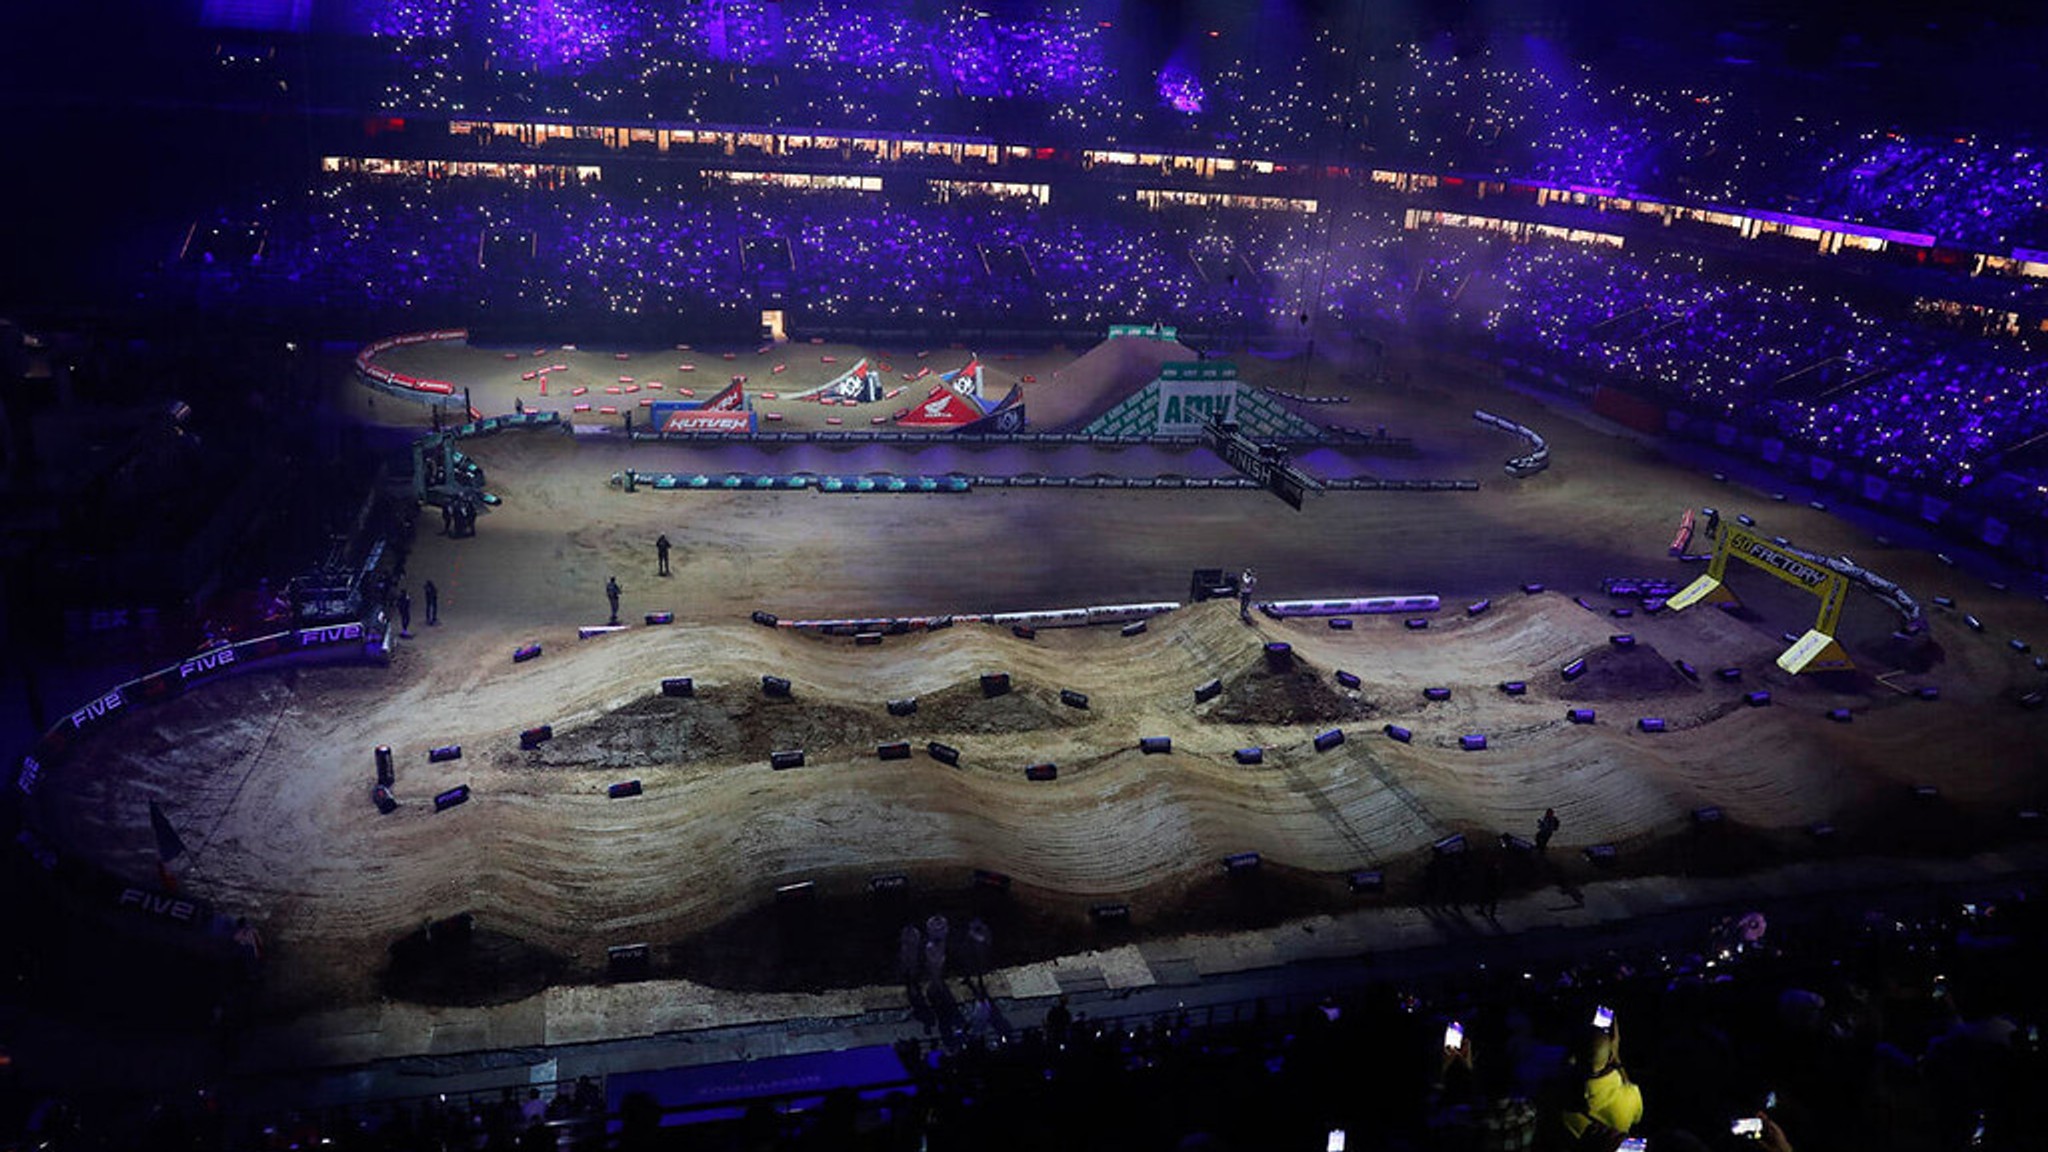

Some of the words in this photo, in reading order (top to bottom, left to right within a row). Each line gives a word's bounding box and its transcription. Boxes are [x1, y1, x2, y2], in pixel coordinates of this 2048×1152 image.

[1226, 444, 1272, 485] FINISH
[302, 624, 361, 646] FIVE
[180, 649, 235, 678] FIVE
[71, 692, 121, 729] FIVE
[119, 888, 196, 920] FIVE
